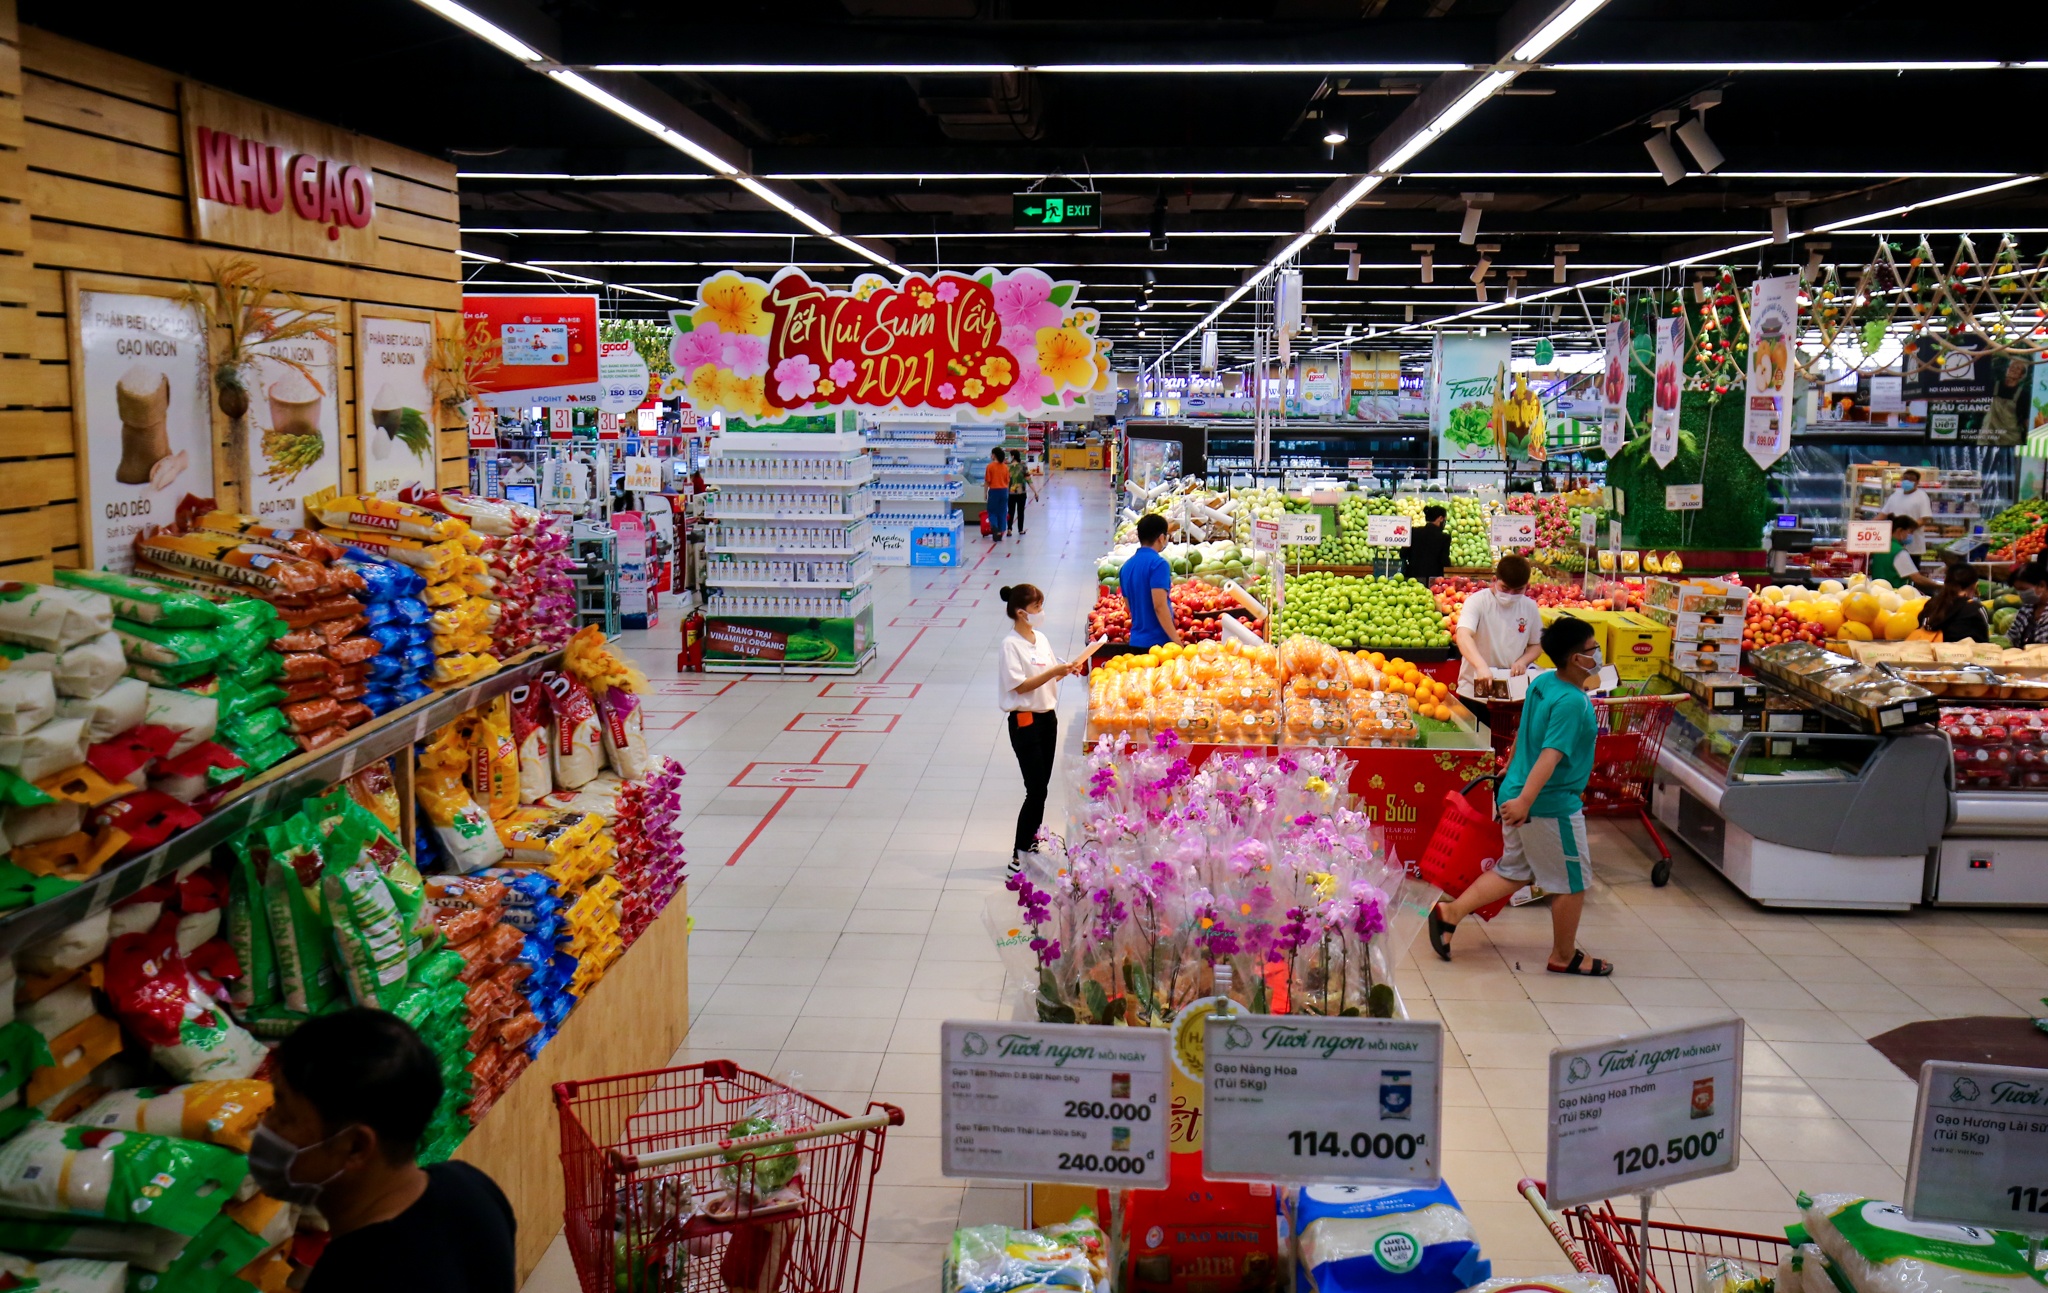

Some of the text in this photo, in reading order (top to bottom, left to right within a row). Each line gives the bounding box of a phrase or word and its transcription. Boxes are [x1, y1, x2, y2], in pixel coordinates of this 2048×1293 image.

[198, 126, 372, 241] KHU GẠO
[1067, 205, 1092, 216] EXIT
[771, 289, 997, 363] Tết Vui Sum Vầy
[117, 338, 177, 359] GẠO NGON
[600, 340, 628, 354] good
[381, 352, 415, 367] GẠO NGON
[857, 350, 933, 398] 2021
[1446, 377, 1496, 400] Fresh
[1932, 403, 1990, 413] HẬU GIANG
[472, 415, 491, 435] 32
[555, 410, 569, 428] 31
[601, 413, 617, 430] 30
[682, 410, 696, 425] 28
[106, 496, 151, 522] GẠO DẺO
[351, 513, 398, 530] MEIZAN
[872, 534, 904, 547] Meadow
[1857, 531, 1882, 541] 50%
[883, 541, 901, 550] Fresh
[190, 556, 219, 576] KIM
[710, 631, 785, 651] VINAMILK ORGANIC
[727, 625, 772, 641] TRANG TRẠI
[746, 646, 760, 657] LẠT
[562, 716, 570, 754] Neptune
[610, 710, 625, 746] Neptune
[479, 748, 488, 791] MEIZAN
[1385, 793, 1416, 822] Sửu
[997, 1034, 1044, 1058] Tươi
[1044, 1044, 1095, 1067] ngon
[1119, 1050, 1146, 1062] NGÀY
[1262, 1025, 1311, 1051] Tươi
[1312, 1034, 1367, 1059] ngon
[1390, 1040, 1419, 1051] NGÀY
[1598, 1043, 1721, 1077] Tươi ngon MỖI NGÀY
[1215, 1063, 1297, 1078] Gạo Nàng Hoa
[1214, 1077, 1267, 1091] (Túi 5Kg)
[1991, 1081, 2043, 1105] Tươi
[1559, 1083, 1656, 1110] Gạo Nàng Hoa Thơm
[1558, 1108, 1602, 1125] (Túi 5Kg)
[1936, 1114, 2048, 1133] Gạo Hương Lài Sữ
[1934, 1129, 1990, 1145] (Túi 5Kg)
[1217, 1231, 1259, 1244] MINH
[1384, 1244, 1411, 1256] minh
